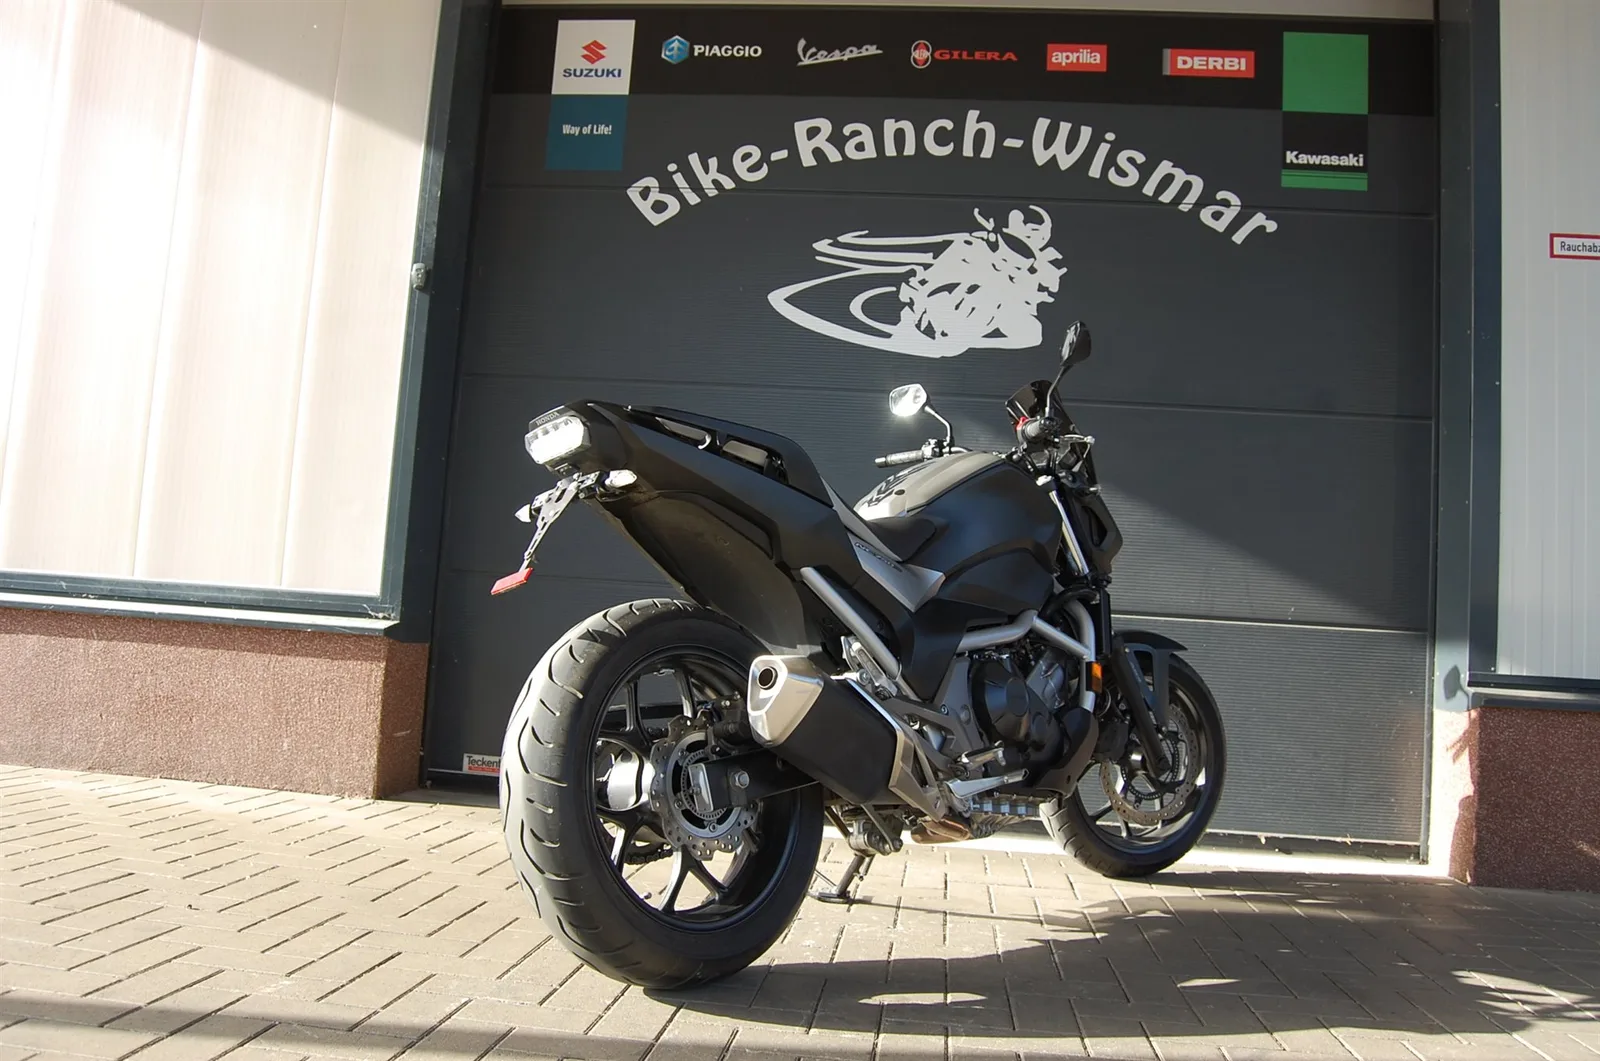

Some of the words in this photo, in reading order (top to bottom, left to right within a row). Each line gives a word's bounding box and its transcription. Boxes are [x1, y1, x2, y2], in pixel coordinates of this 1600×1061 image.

[693, 44, 763, 58] PIAGGIO
[796, 37, 884, 66] Vespa
[933, 48, 1018, 61] GILERA
[1051, 48, 1101, 67] aprilia
[1176, 55, 1247, 71] DERBI
[562, 67, 622, 78] SUZUKI
[562, 124, 581, 137] Way
[582, 124, 592, 135] of
[593, 124, 612, 135] Life!
[1285, 150, 1364, 168] Kawasaki
[626, 109, 1278, 245] Bike-Ranch-Wismar
[535, 411, 560, 426] HONDA
